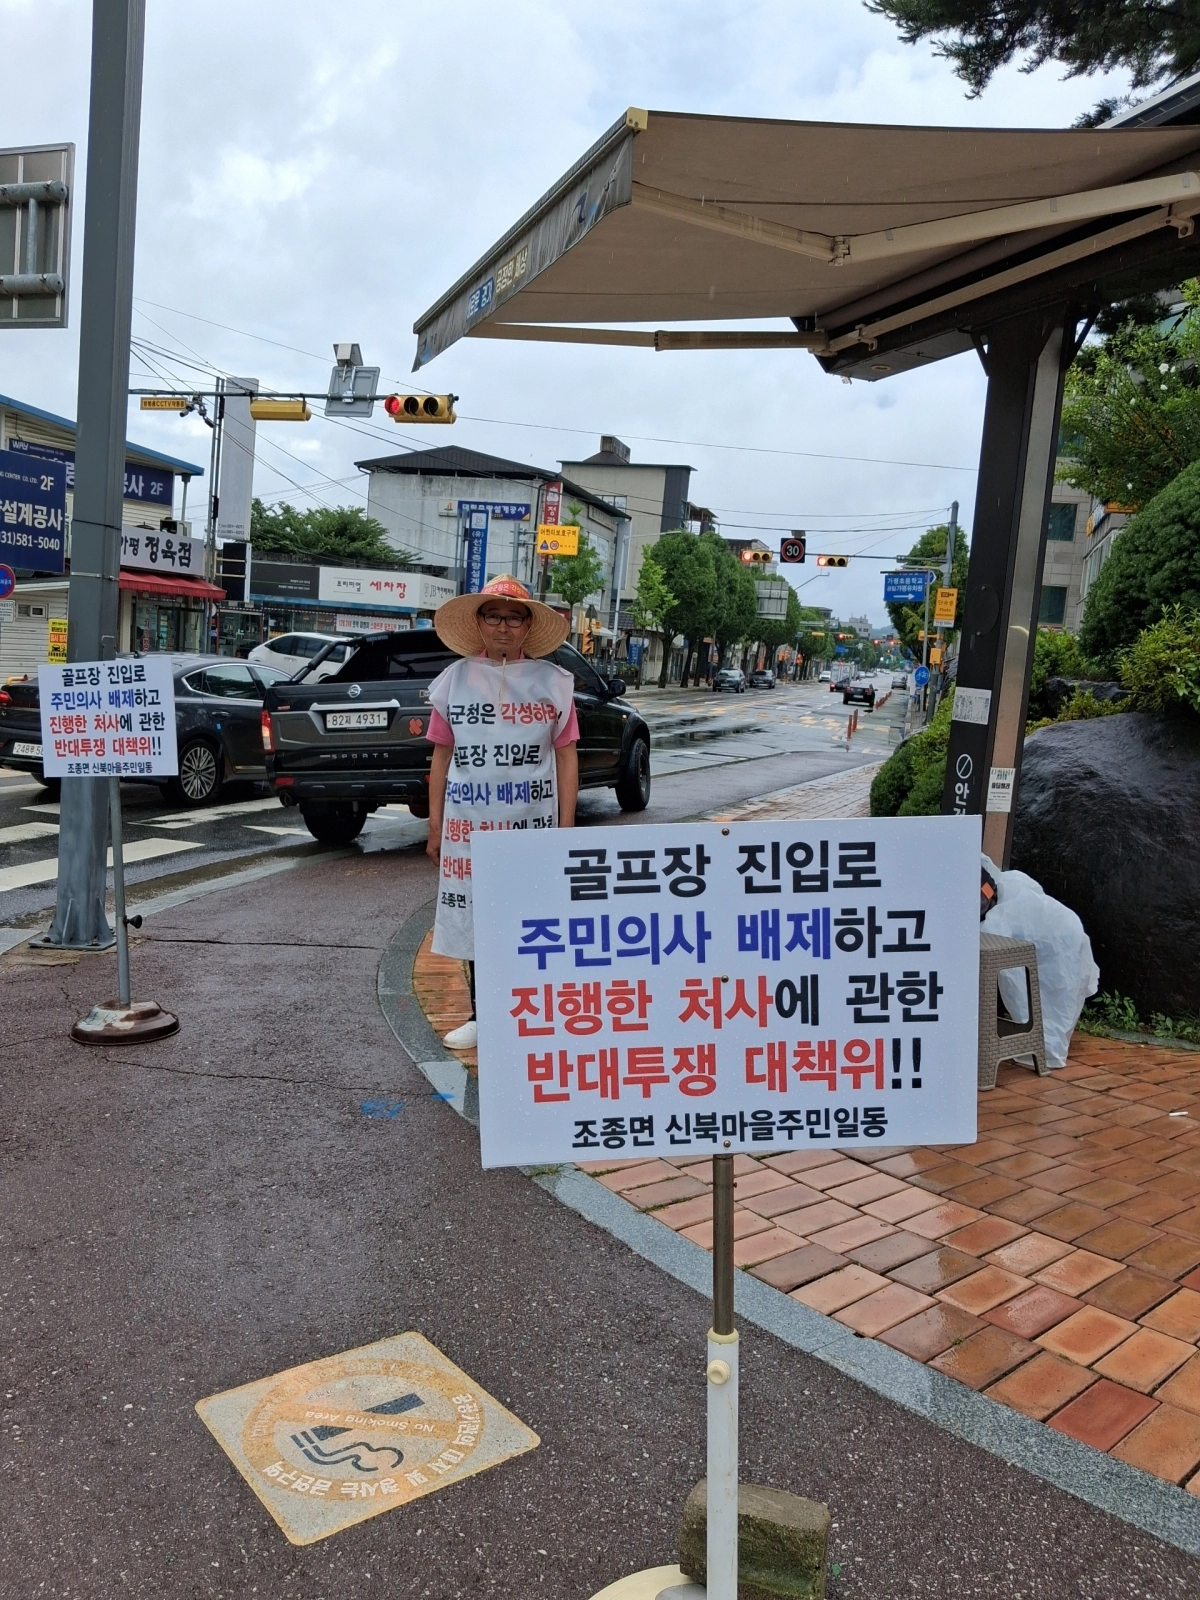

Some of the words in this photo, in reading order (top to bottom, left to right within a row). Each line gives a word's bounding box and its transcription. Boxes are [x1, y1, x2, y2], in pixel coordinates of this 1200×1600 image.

[12, 440, 28, 451] WAY
[5, 472, 20, 480] CENTER
[41, 475, 54, 491] 2F
[151, 482, 163, 495] 2F
[0, 499, 63, 531] 설계공사
[540, 528, 577, 537] 어린이보호구역
[145, 536, 192, 568] 정육점
[786, 545, 800, 557] 30
[337, 581, 361, 592] 프리미엄
[370, 581, 407, 599] 세차장
[887, 577, 923, 585] 가평초등학교
[62, 667, 100, 687] 골프장
[107, 664, 146, 684] 진입로
[51, 690, 102, 711] 주민의사
[108, 688, 161, 708] 배제하고
[50, 714, 87, 734] 진행한
[94, 713, 133, 733] 처사에
[139, 711, 165, 731] 관한
[356, 714, 381, 725] 4931
[447, 702, 496, 725] 군청은
[55, 738, 106, 757] 반대투쟁
[113, 736, 162, 756] 대책위!!
[68, 762, 90, 774] 조종면
[92, 761, 152, 774] 신북마을주민일동
[497, 779, 553, 805] 배제하고
[564, 844, 711, 900] 골프장
[736, 840, 882, 895] 진입로
[517, 910, 712, 970] 주민의사
[737, 906, 931, 961] 배제하고
[510, 979, 653, 1037] 진행한
[678, 973, 820, 1030] 처사에
[845, 970, 943, 1025] 관한
[527, 1044, 718, 1103] 반대투쟁
[745, 1037, 923, 1094] 대책위!!
[572, 1114, 655, 1149] 조종면
[665, 1106, 889, 1145] 신북마을주민일동
[304, 1410, 340, 1421] Area
[344, 1414, 409, 1430] Smoking
[451, 1392, 477, 1447] 공공기관의
[413, 1423, 434, 1433] No
[427, 1448, 465, 1475] 대지
[262, 1460, 333, 1496] 금연구역
[340, 1478, 399, 1498] 청사는
[404, 1469, 429, 1487] 및
